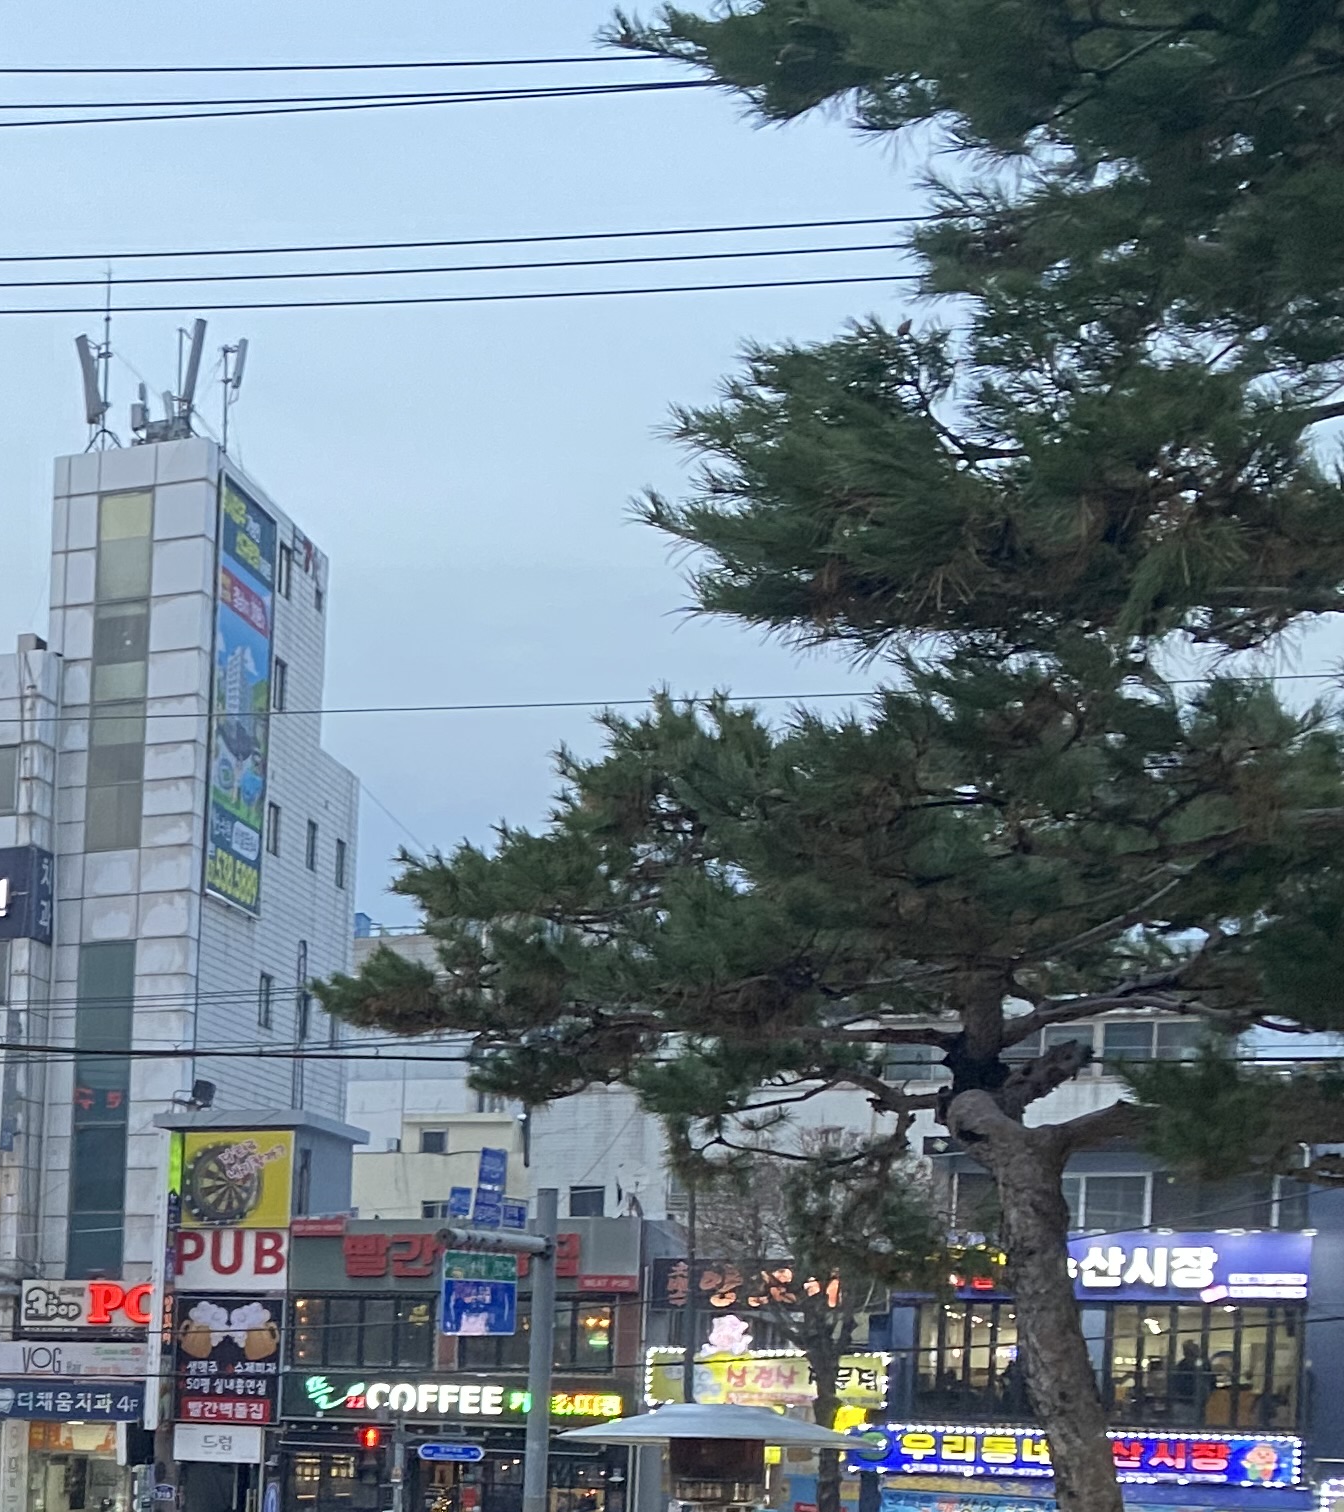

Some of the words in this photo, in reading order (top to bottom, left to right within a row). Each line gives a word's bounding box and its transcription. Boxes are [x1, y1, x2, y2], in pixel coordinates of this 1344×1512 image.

[174, 1231, 286, 1276] PUB
[1067, 1245, 1219, 1289] 산시장
[87, 1283, 154, 1324] PC
[22, 1347, 62, 1374] VOG
[186, 1360, 219, 1375] 생맥주
[234, 1361, 277, 1375] 수제피자
[186, 1378, 211, 1393] 50평
[17, 1391, 113, 1413] 더채움치과
[116, 1396, 139, 1412] 4F
[187, 1401, 265, 1421] 빨간벽돌집
[366, 1382, 505, 1416] COFFEE
[201, 1435, 233, 1452] 드럼
